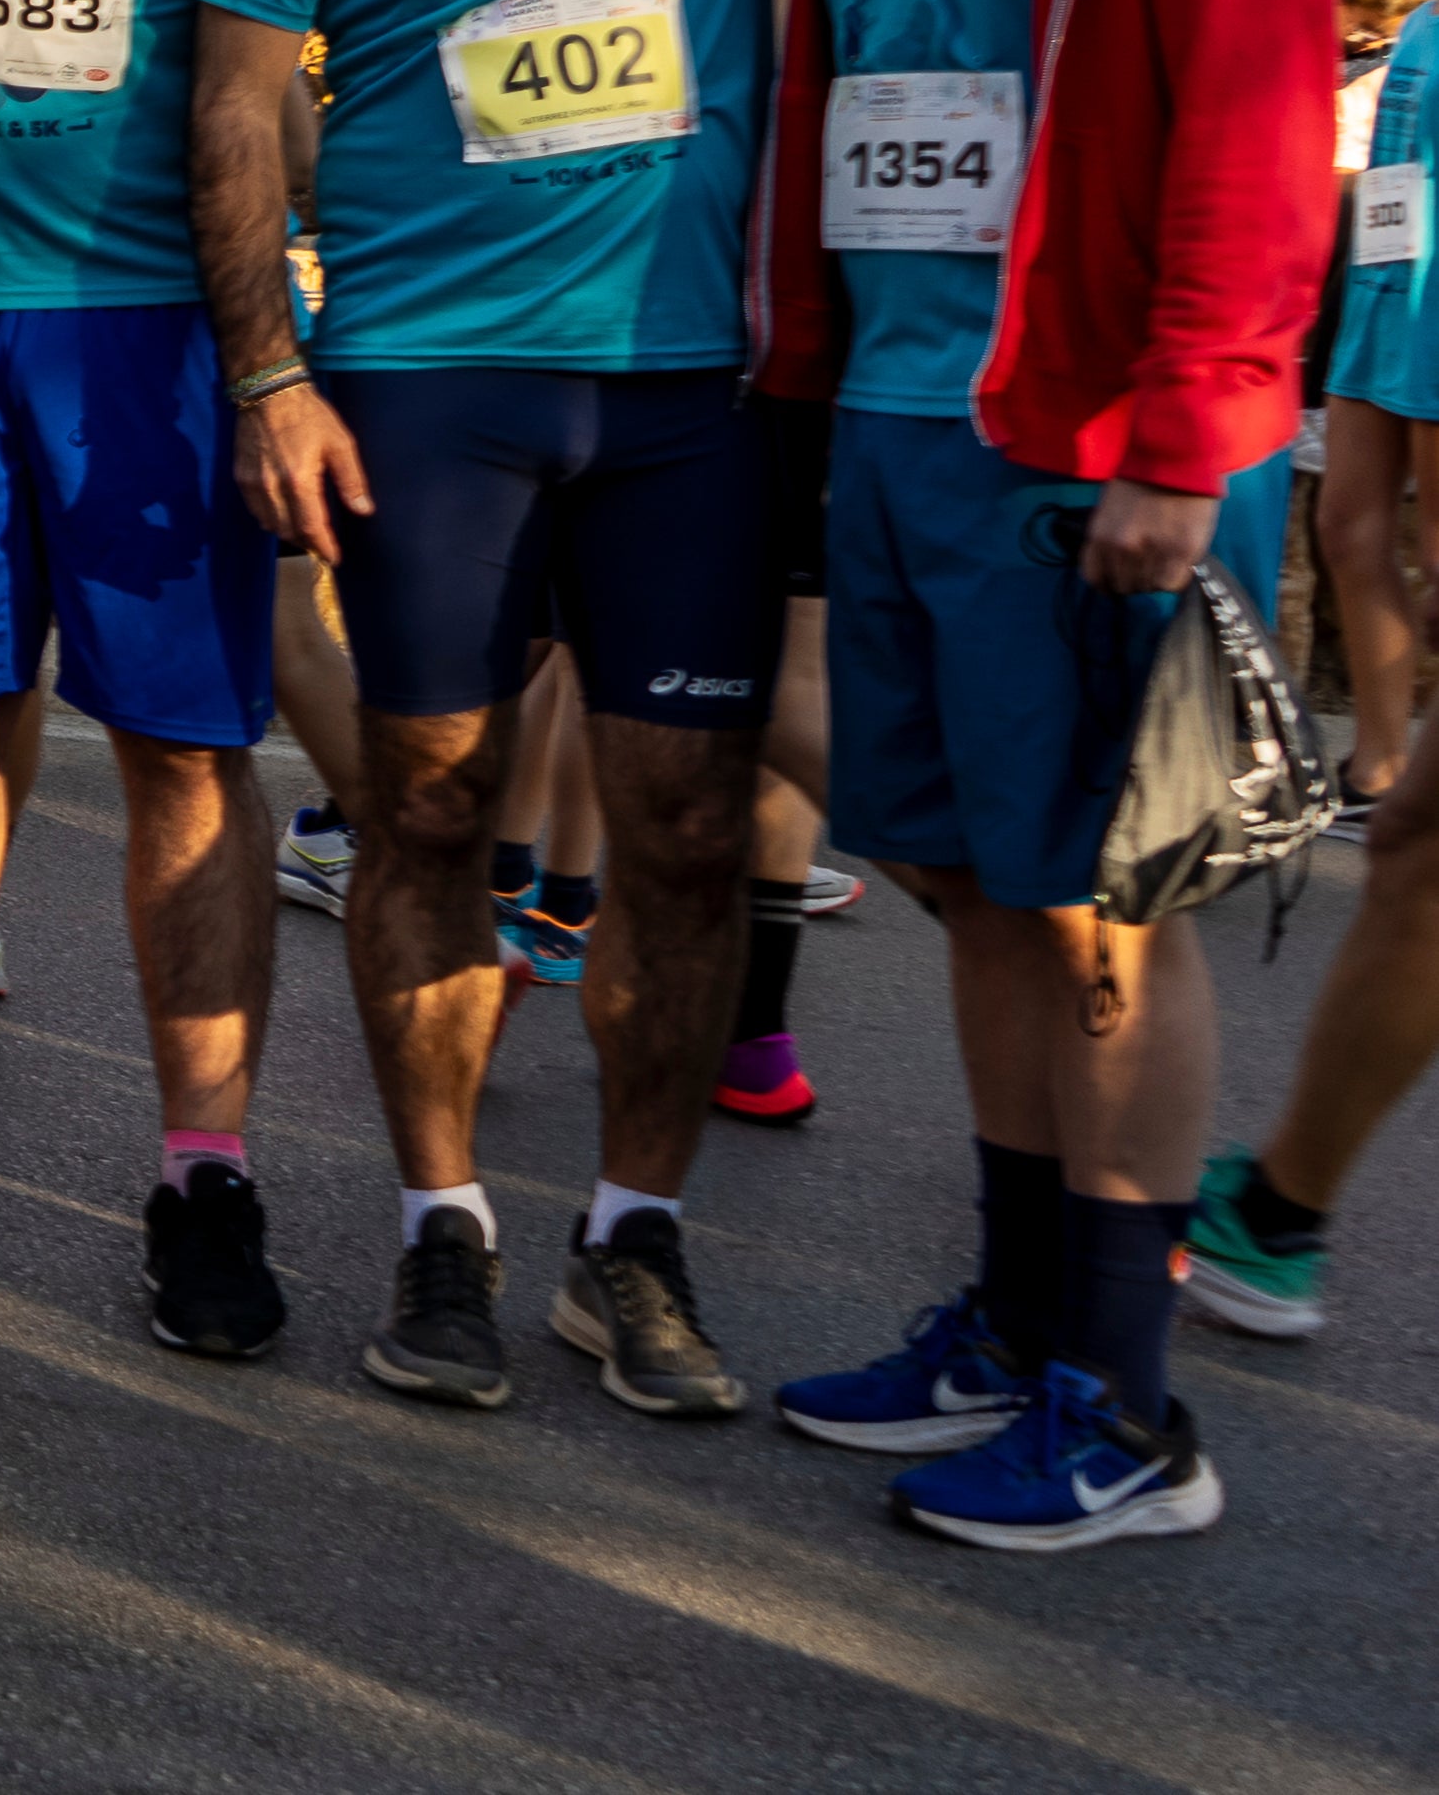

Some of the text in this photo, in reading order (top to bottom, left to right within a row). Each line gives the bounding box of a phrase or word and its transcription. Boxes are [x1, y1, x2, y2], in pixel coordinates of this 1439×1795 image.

[502, 26, 653, 101] 402
[7, 120, 24, 137] &
[29, 120, 61, 137] 5K
[843, 140, 996, 189] 1354
[685, 677, 755, 697] asics
